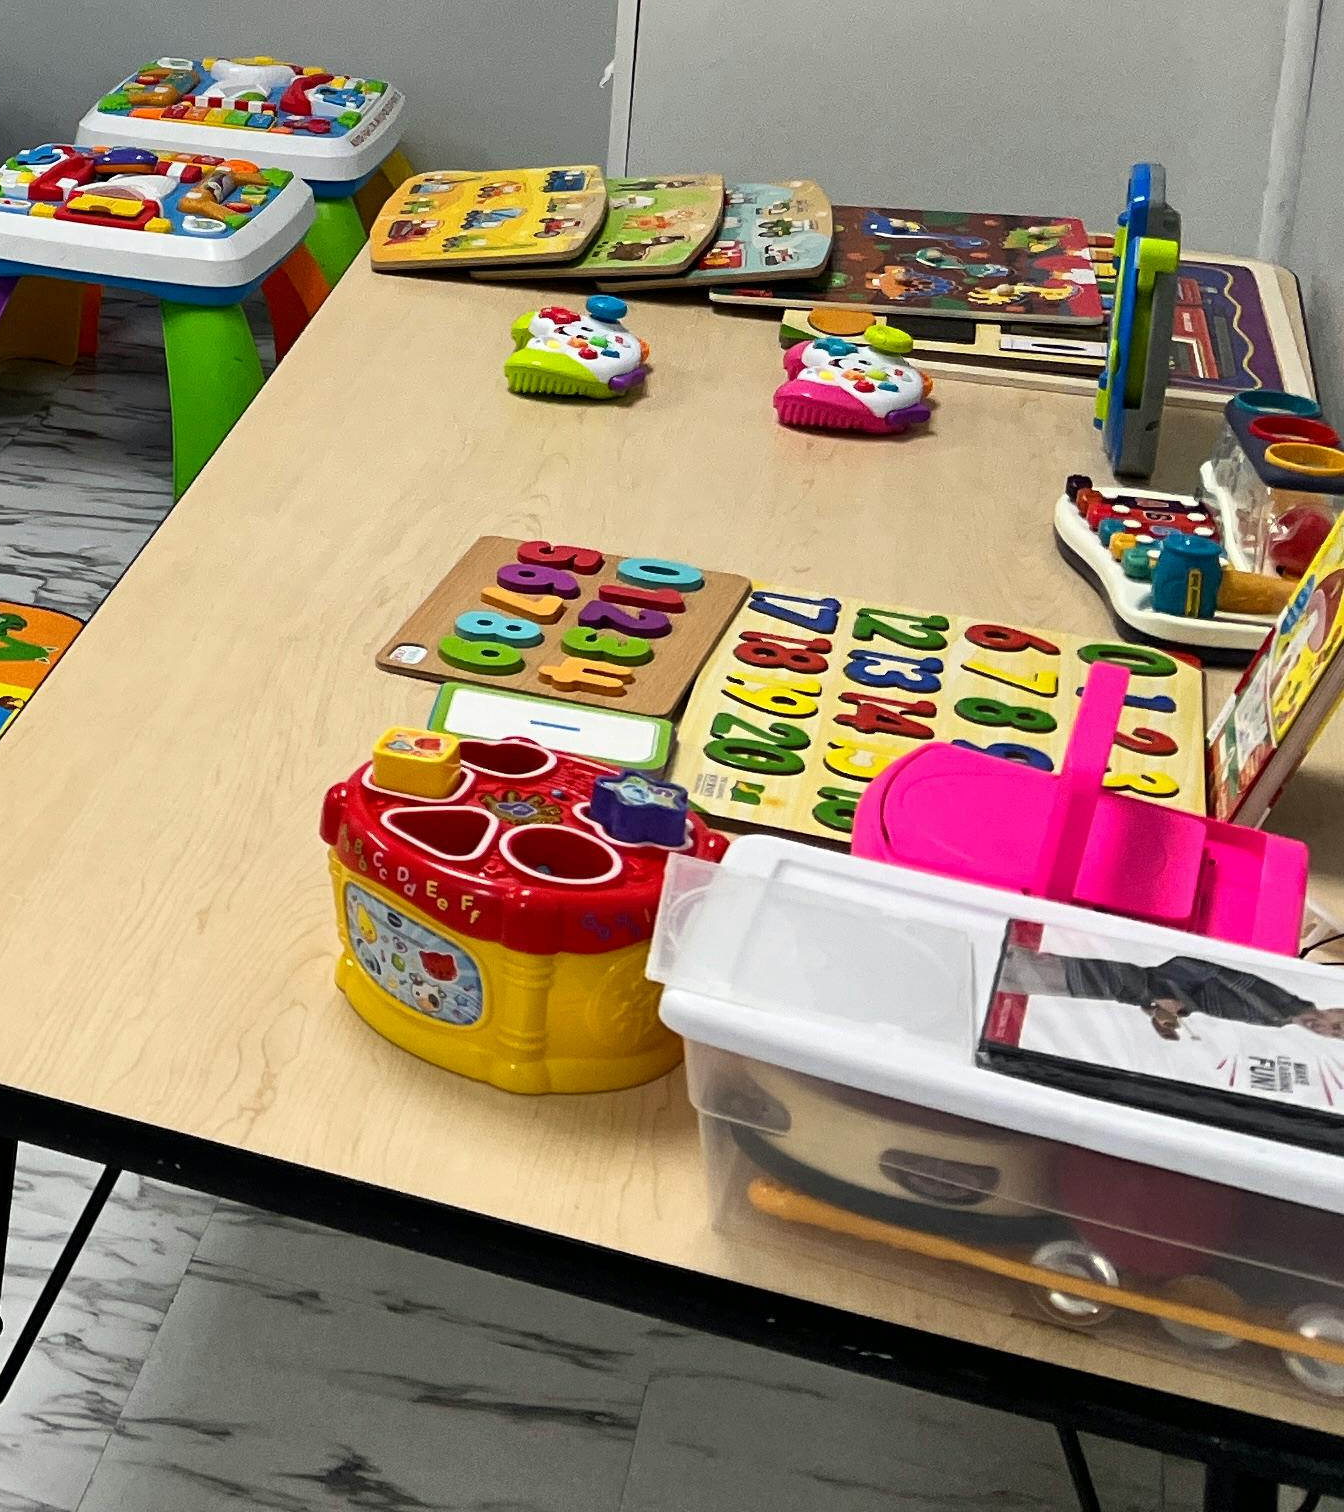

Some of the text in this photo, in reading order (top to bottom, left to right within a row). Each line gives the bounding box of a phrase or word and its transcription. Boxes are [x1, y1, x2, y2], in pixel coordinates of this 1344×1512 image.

[438, 540, 605, 675] 5 6 7 8 9
[537, 558, 704, 697] 0 1 2 3 4
[852, 607, 949, 651] 12
[964, 624, 1061, 655] 6
[703, 591, 841, 776] 17 18 19 20
[843, 649, 944, 694] 13
[960, 661, 1059, 698] 7
[832, 691, 937, 739] 14
[954, 696, 1058, 734] 8
[396, 866, 417, 898] Dd
[425, 880, 449, 912] Ee
[460, 894, 481, 925] Ff
[1248, 1055, 1278, 1092] FUN!
